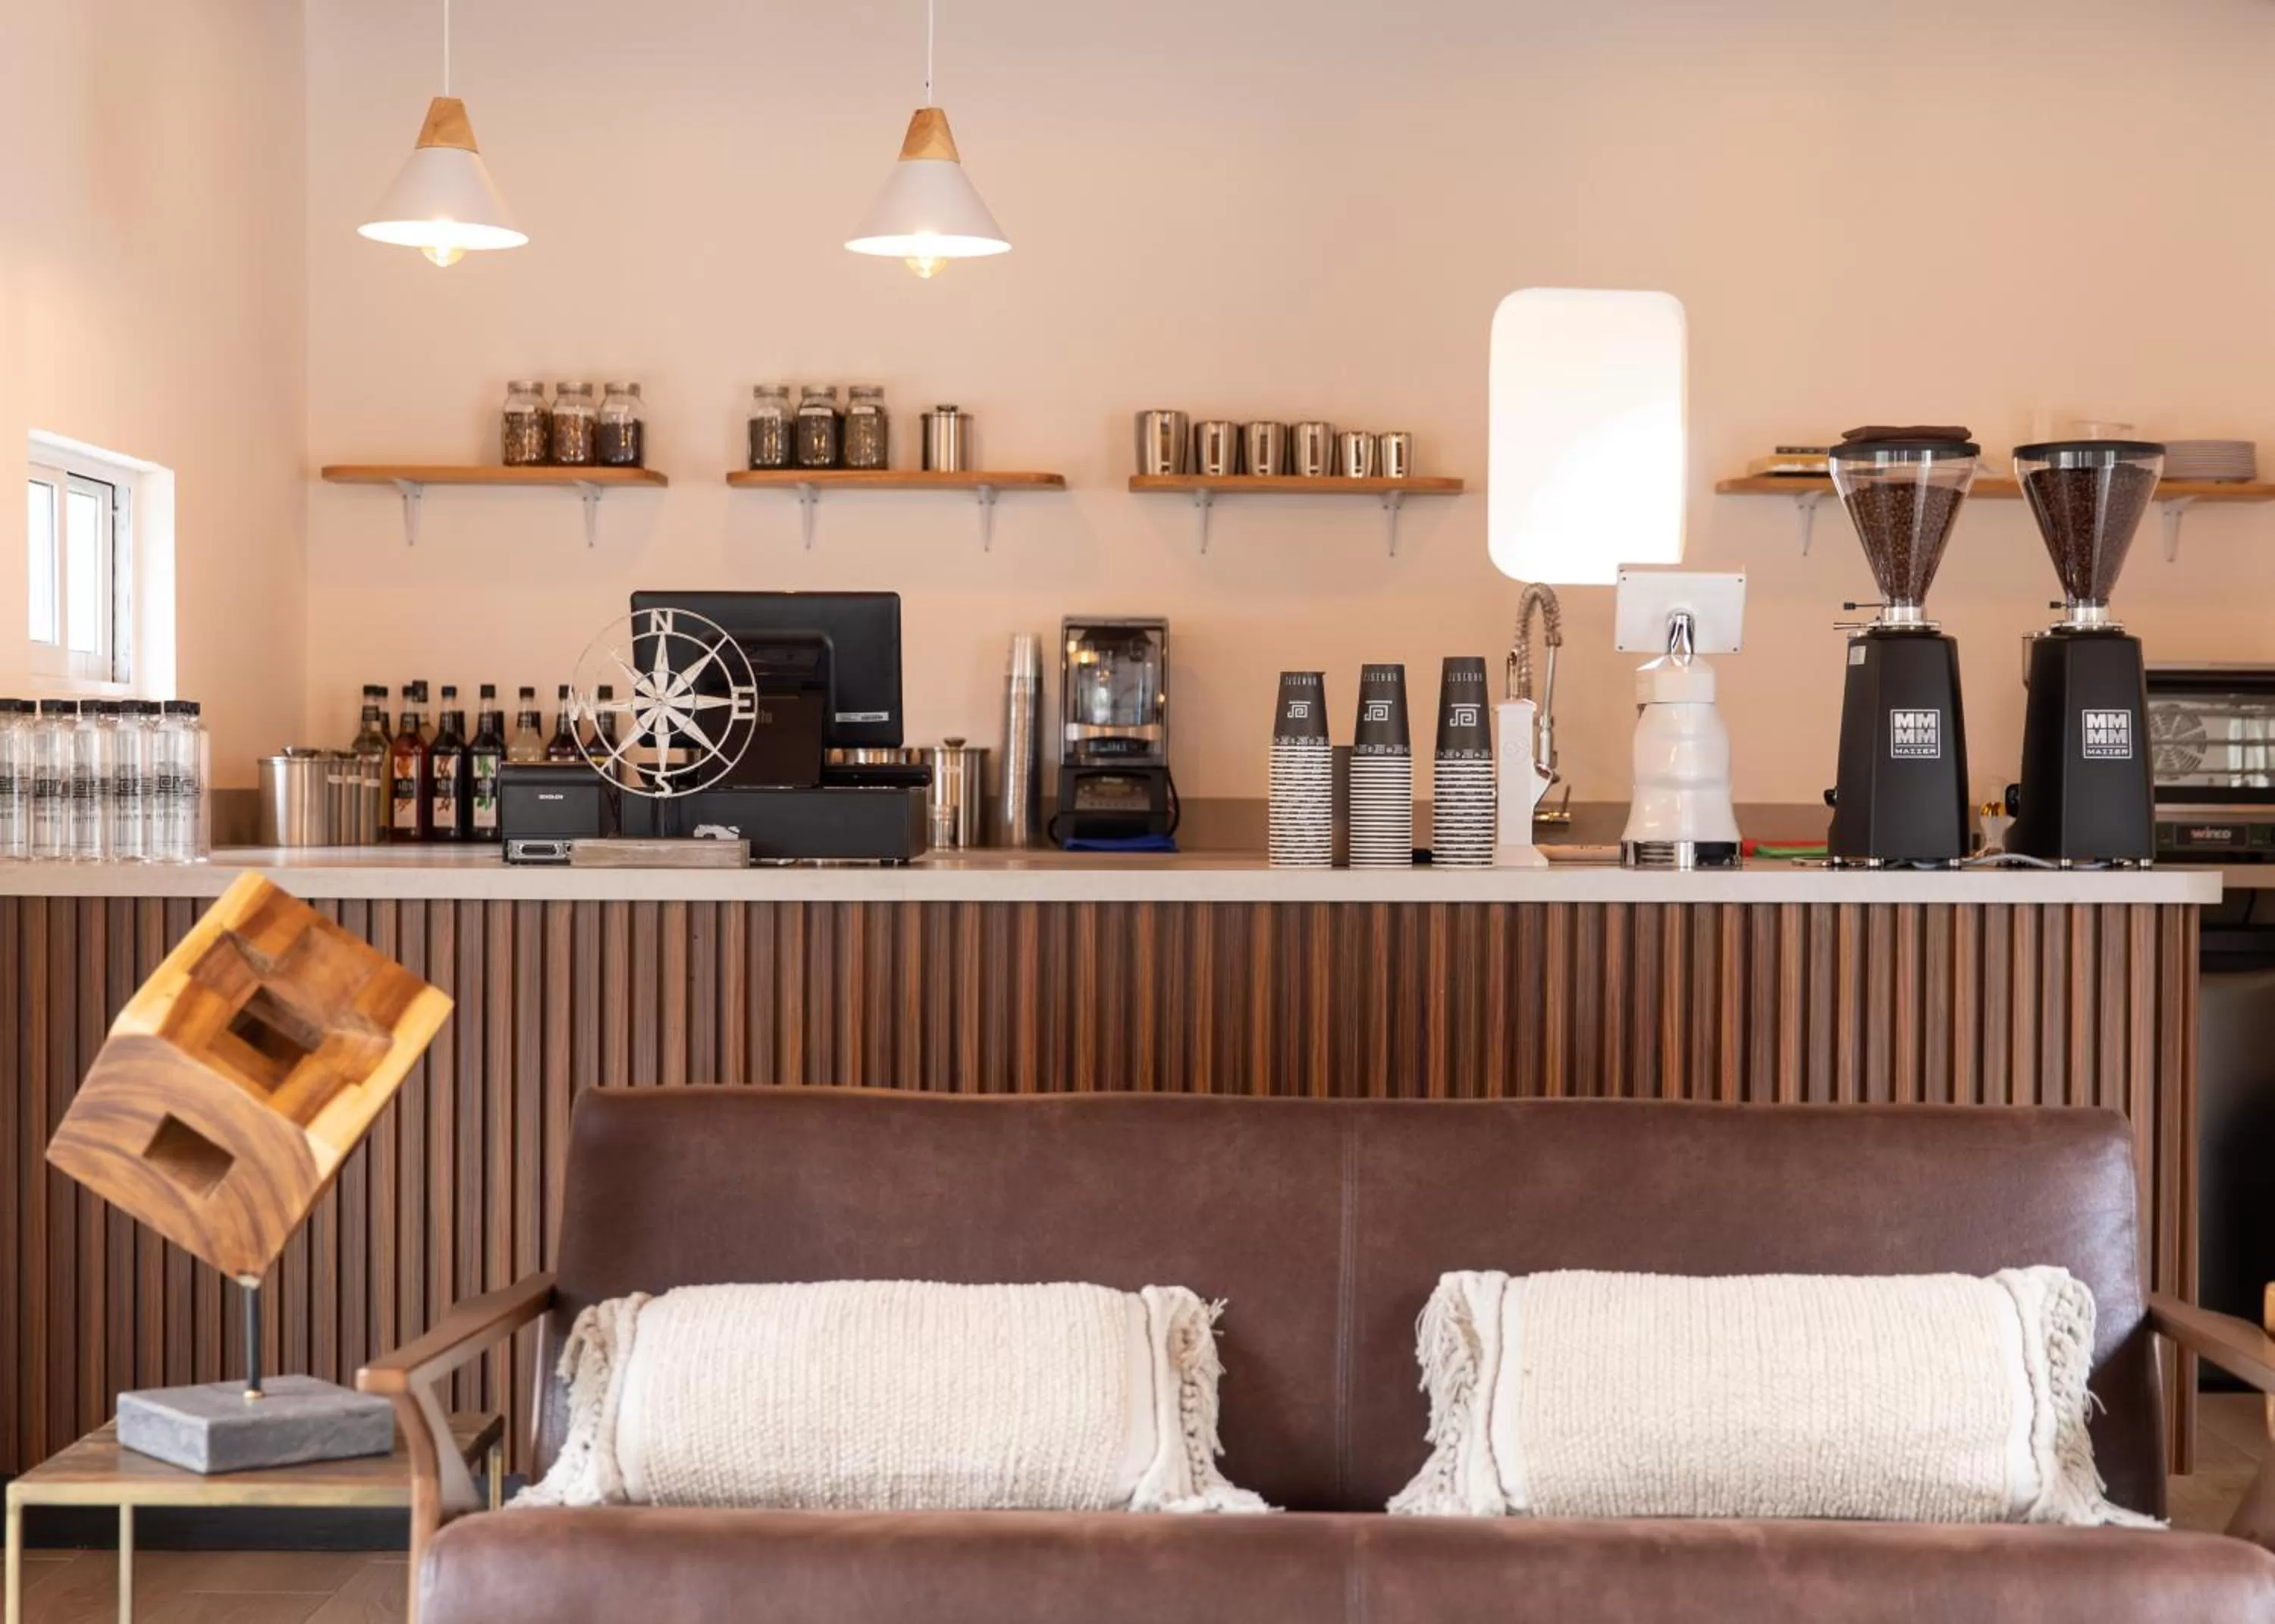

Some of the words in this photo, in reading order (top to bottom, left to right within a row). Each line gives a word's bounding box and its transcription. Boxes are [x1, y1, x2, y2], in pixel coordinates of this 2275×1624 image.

[650, 609, 673, 634] N
[569, 684, 597, 721] W
[732, 686, 757, 720] E
[654, 772, 673, 798] S
